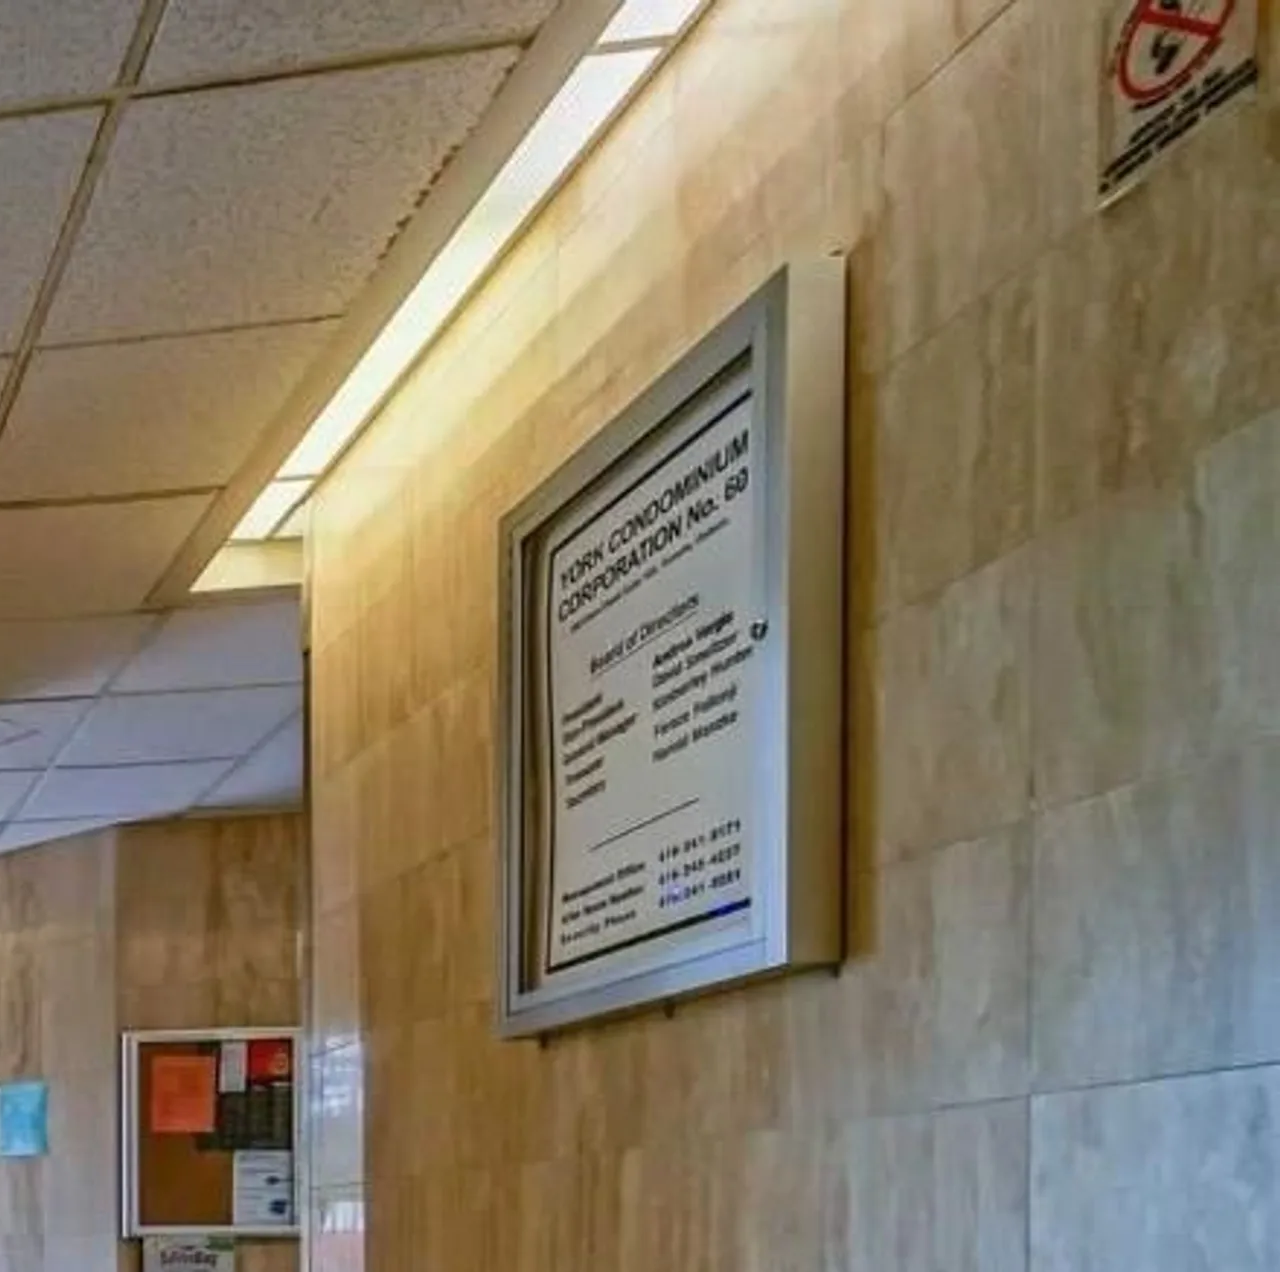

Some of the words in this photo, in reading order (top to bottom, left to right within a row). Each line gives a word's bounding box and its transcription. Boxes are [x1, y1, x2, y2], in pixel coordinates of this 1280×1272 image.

[559, 515, 682, 623] CORPORATION
[687, 497, 719, 528] No.
[561, 541, 604, 589] YORK
[608, 429, 749, 553] CONDOMINIUM
